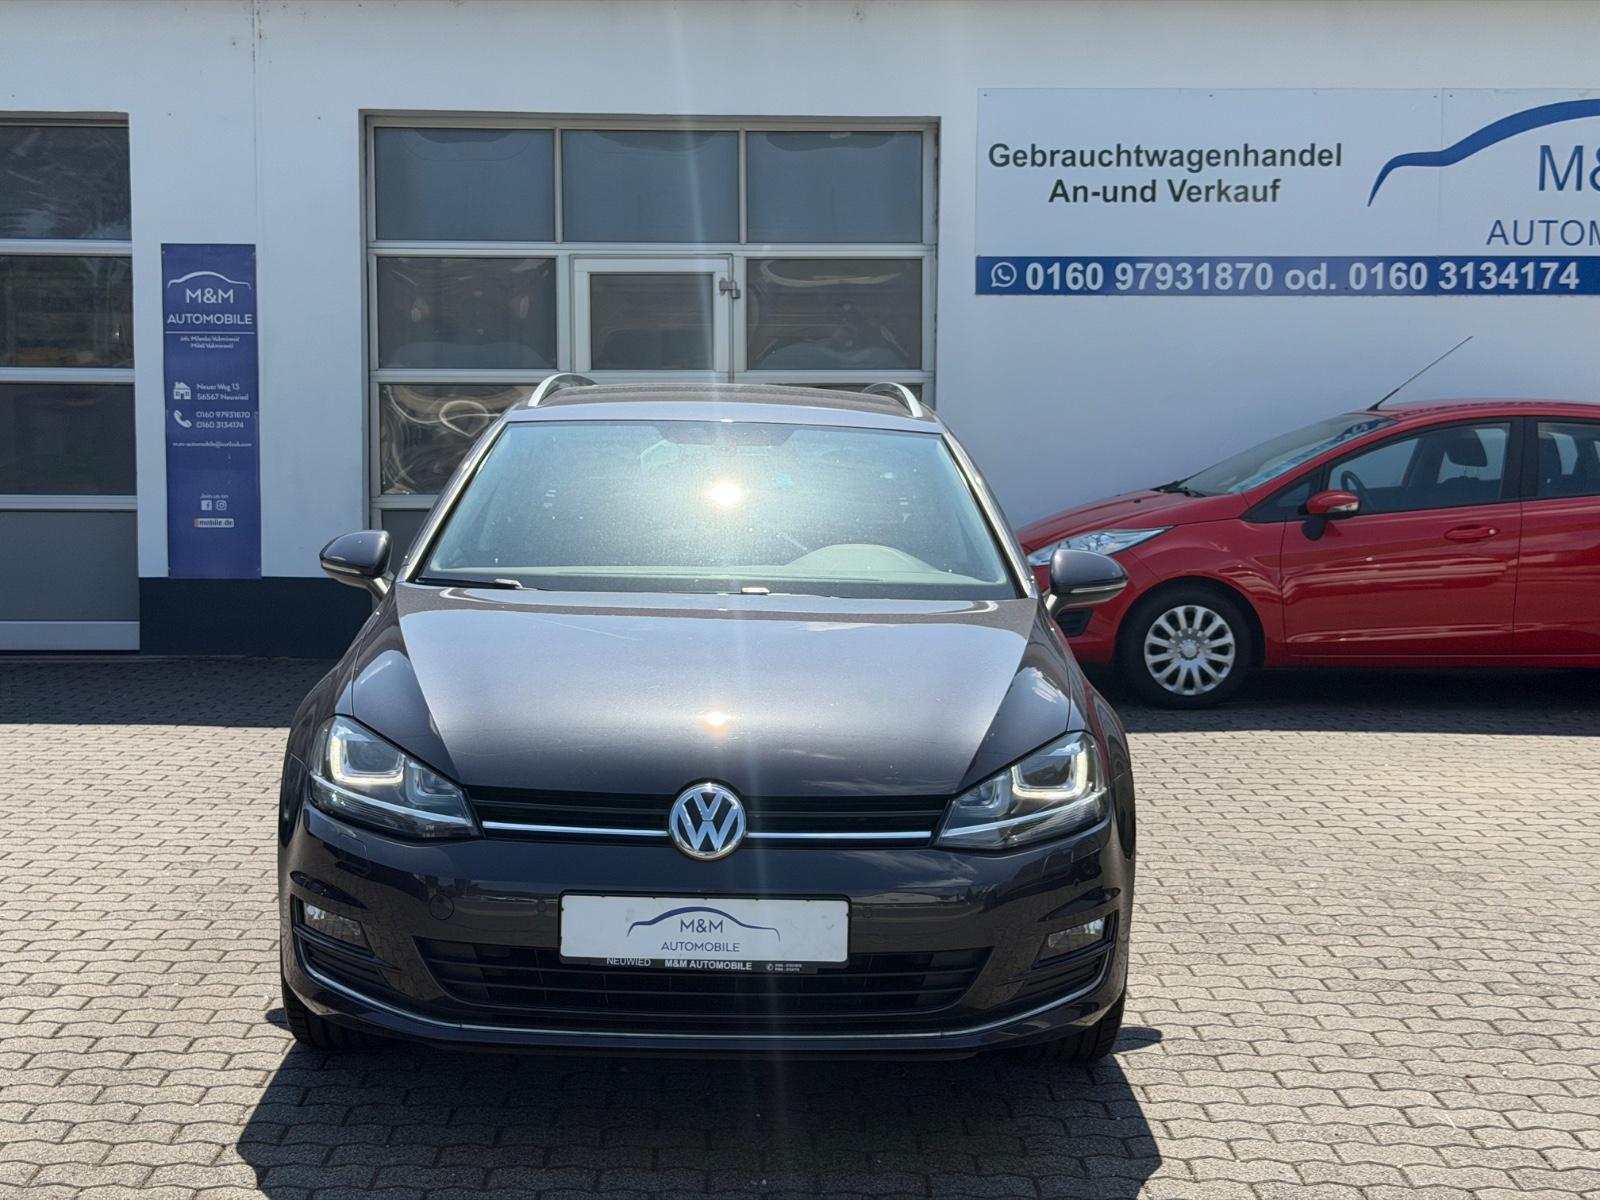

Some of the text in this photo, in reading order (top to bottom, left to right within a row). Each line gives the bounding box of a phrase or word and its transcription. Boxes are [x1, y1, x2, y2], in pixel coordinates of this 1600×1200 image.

[988, 143, 1342, 173] Gebrauchtwagenhandel
[1537, 144, 1600, 191] M
[1048, 178, 1281, 203] An-und Verkauf
[1025, 262, 1580, 291] 0160 97931870 od. 0160 3134174
[185, 288, 234, 304] M&M
[167, 313, 254, 325] AUTOMOBILE
[679, 919, 724, 933] M&M
[660, 941, 741, 953] AUTOMOBILE
[606, 957, 753, 971] NEUWIED M&M AUTOMOBILE
